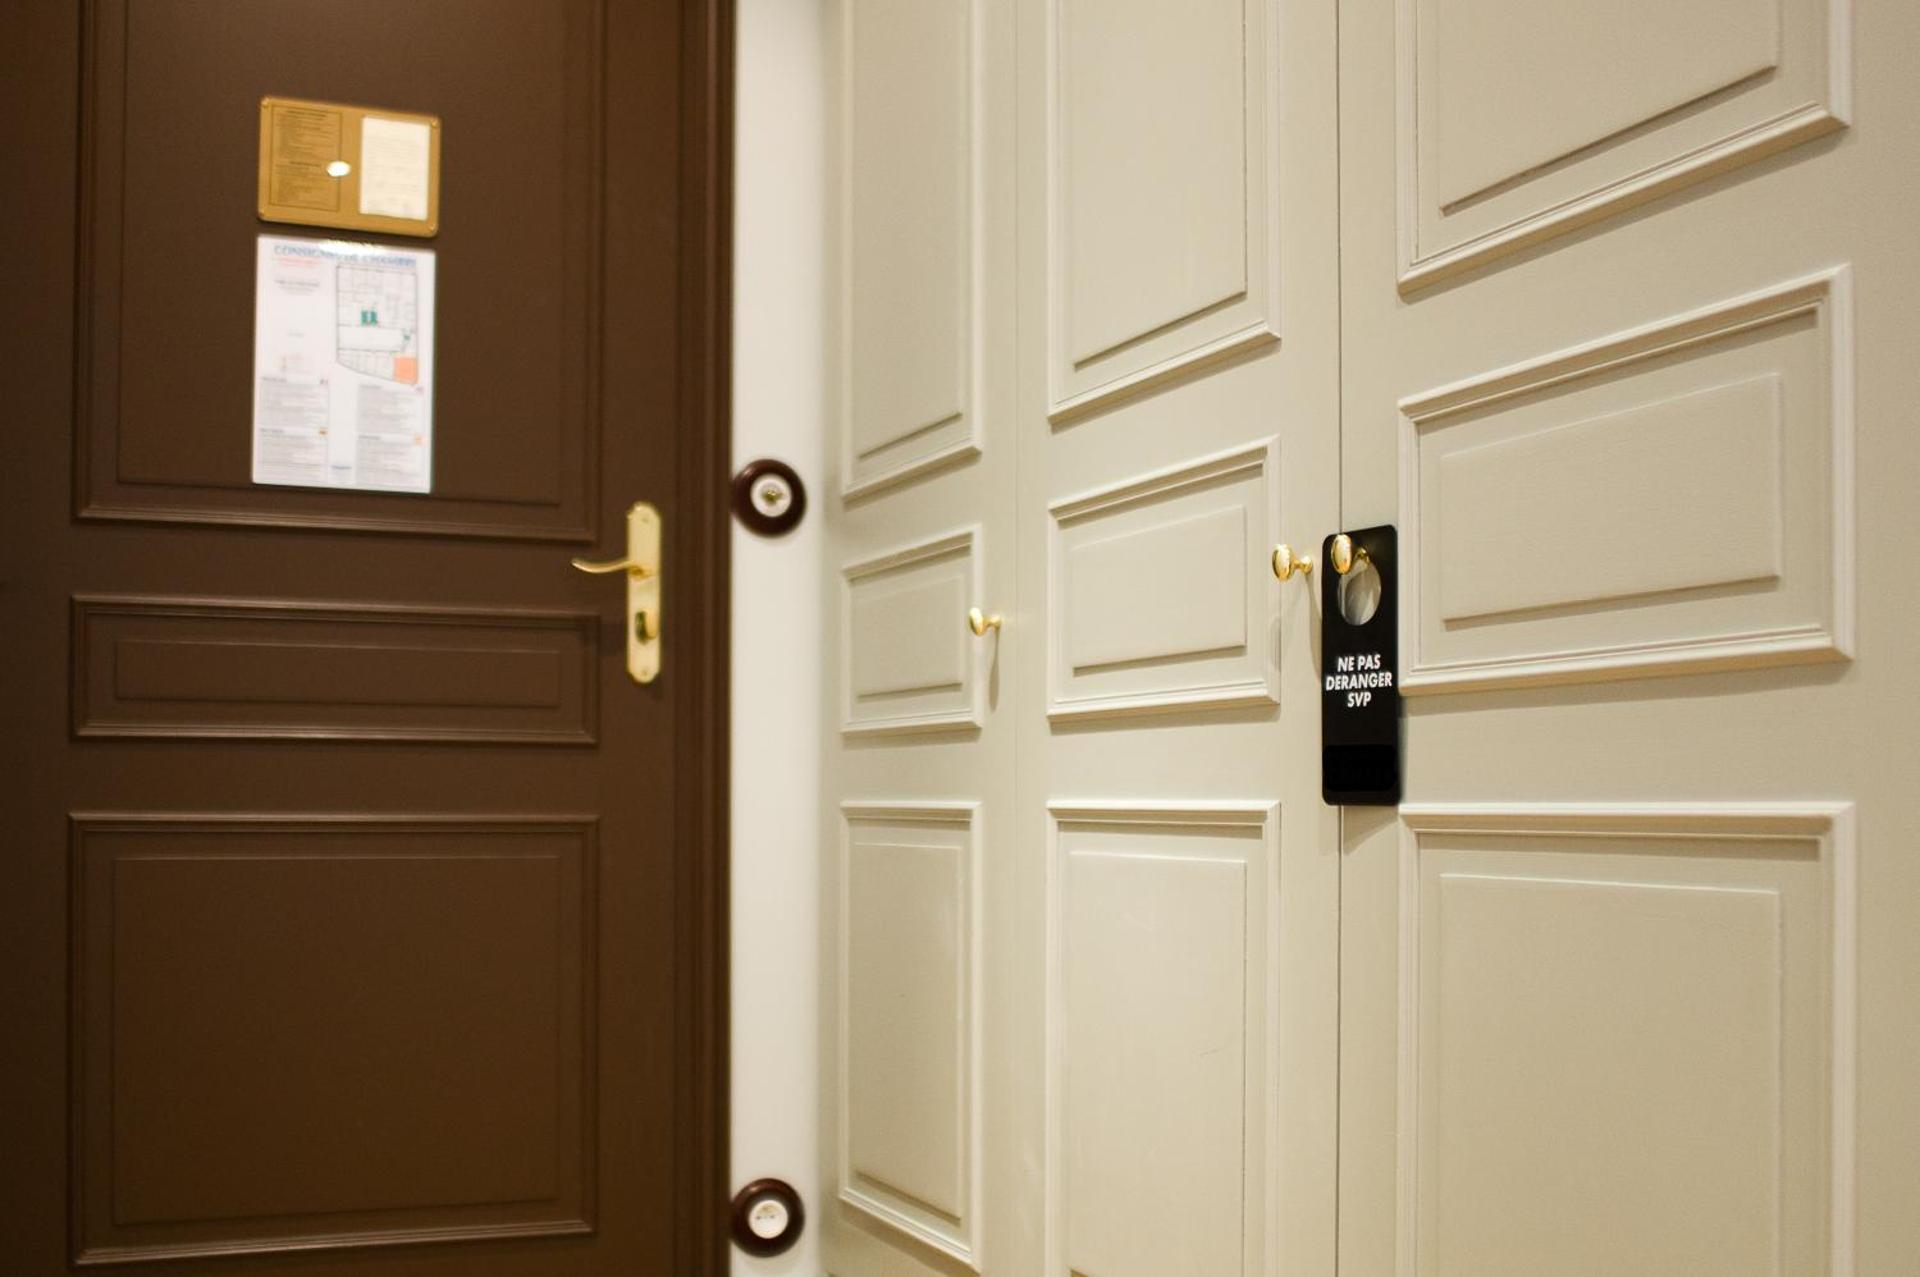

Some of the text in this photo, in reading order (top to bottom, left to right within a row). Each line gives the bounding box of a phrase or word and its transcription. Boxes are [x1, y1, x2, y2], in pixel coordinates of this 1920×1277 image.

[1337, 654, 1381, 672] NE PAS
[1325, 672, 1392, 691] DERANGER
[1347, 691, 1372, 708] SVP
